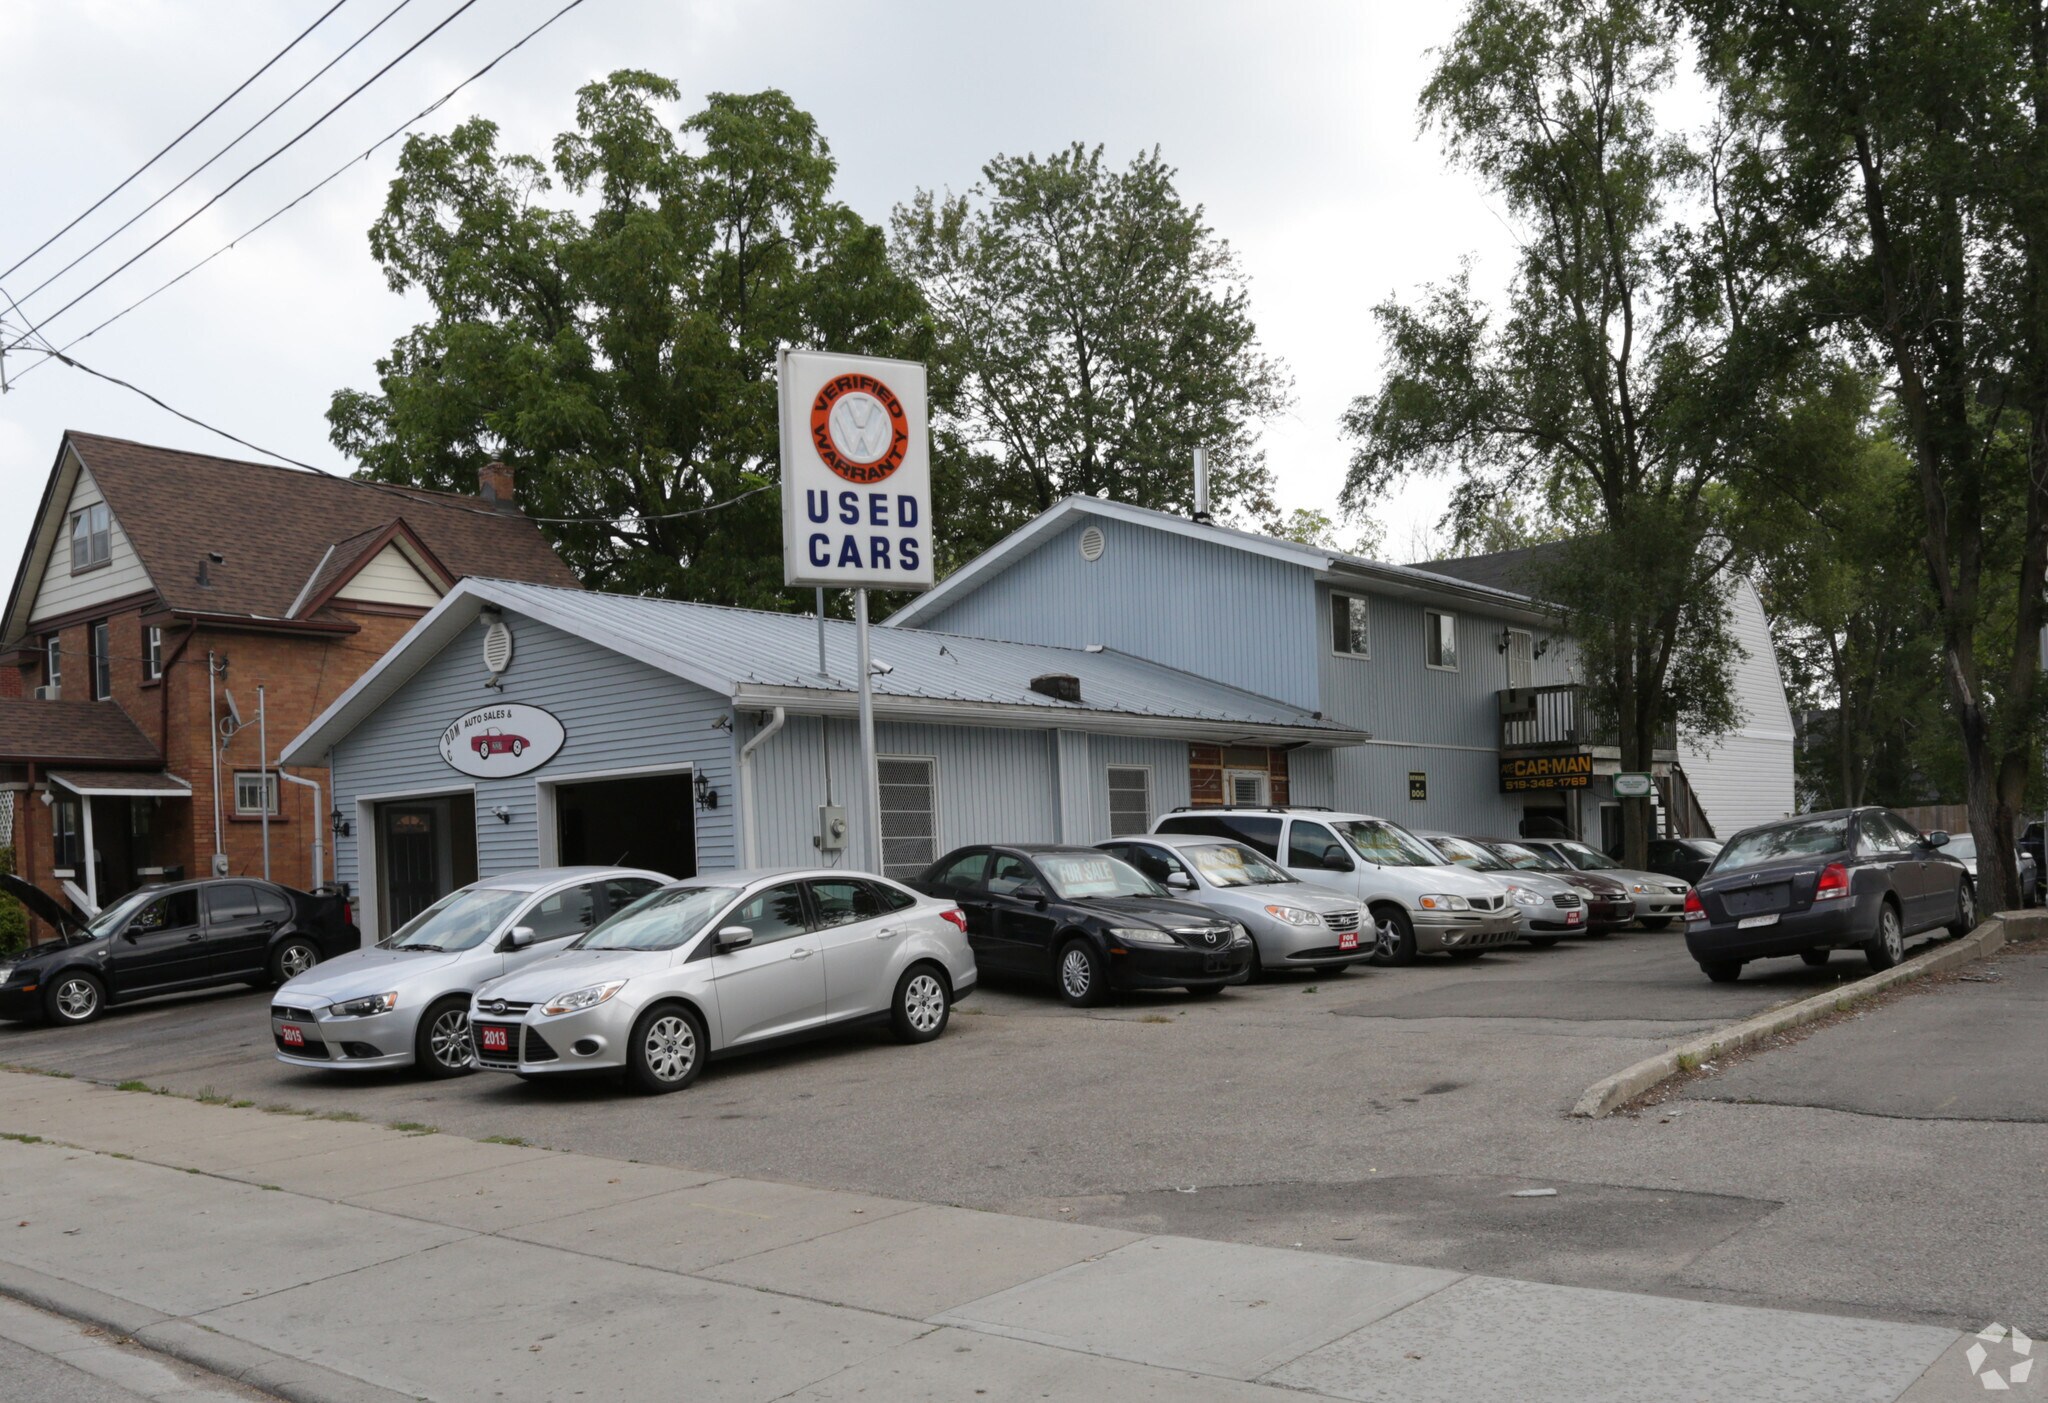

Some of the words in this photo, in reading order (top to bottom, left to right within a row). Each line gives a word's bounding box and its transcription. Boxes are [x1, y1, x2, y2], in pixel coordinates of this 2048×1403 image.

[815, 376, 903, 418] VERIFIED
[814, 423, 907, 481] WARRANTY
[807, 489, 918, 528] USED
[808, 533, 920, 571] CARS
[464, 714, 482, 728] AUTO
[483, 710, 505, 721] SALES
[507, 709, 512, 718] &
[1411, 789, 1424, 798] DOG
[1197, 852, 1216, 865] FOR
[1059, 863, 1083, 883] FOR
[1084, 861, 1113, 881] SALE
[1341, 940, 1357, 948] SALE
[283, 1028, 302, 1043] 2015
[484, 1031, 506, 1046] 2013
